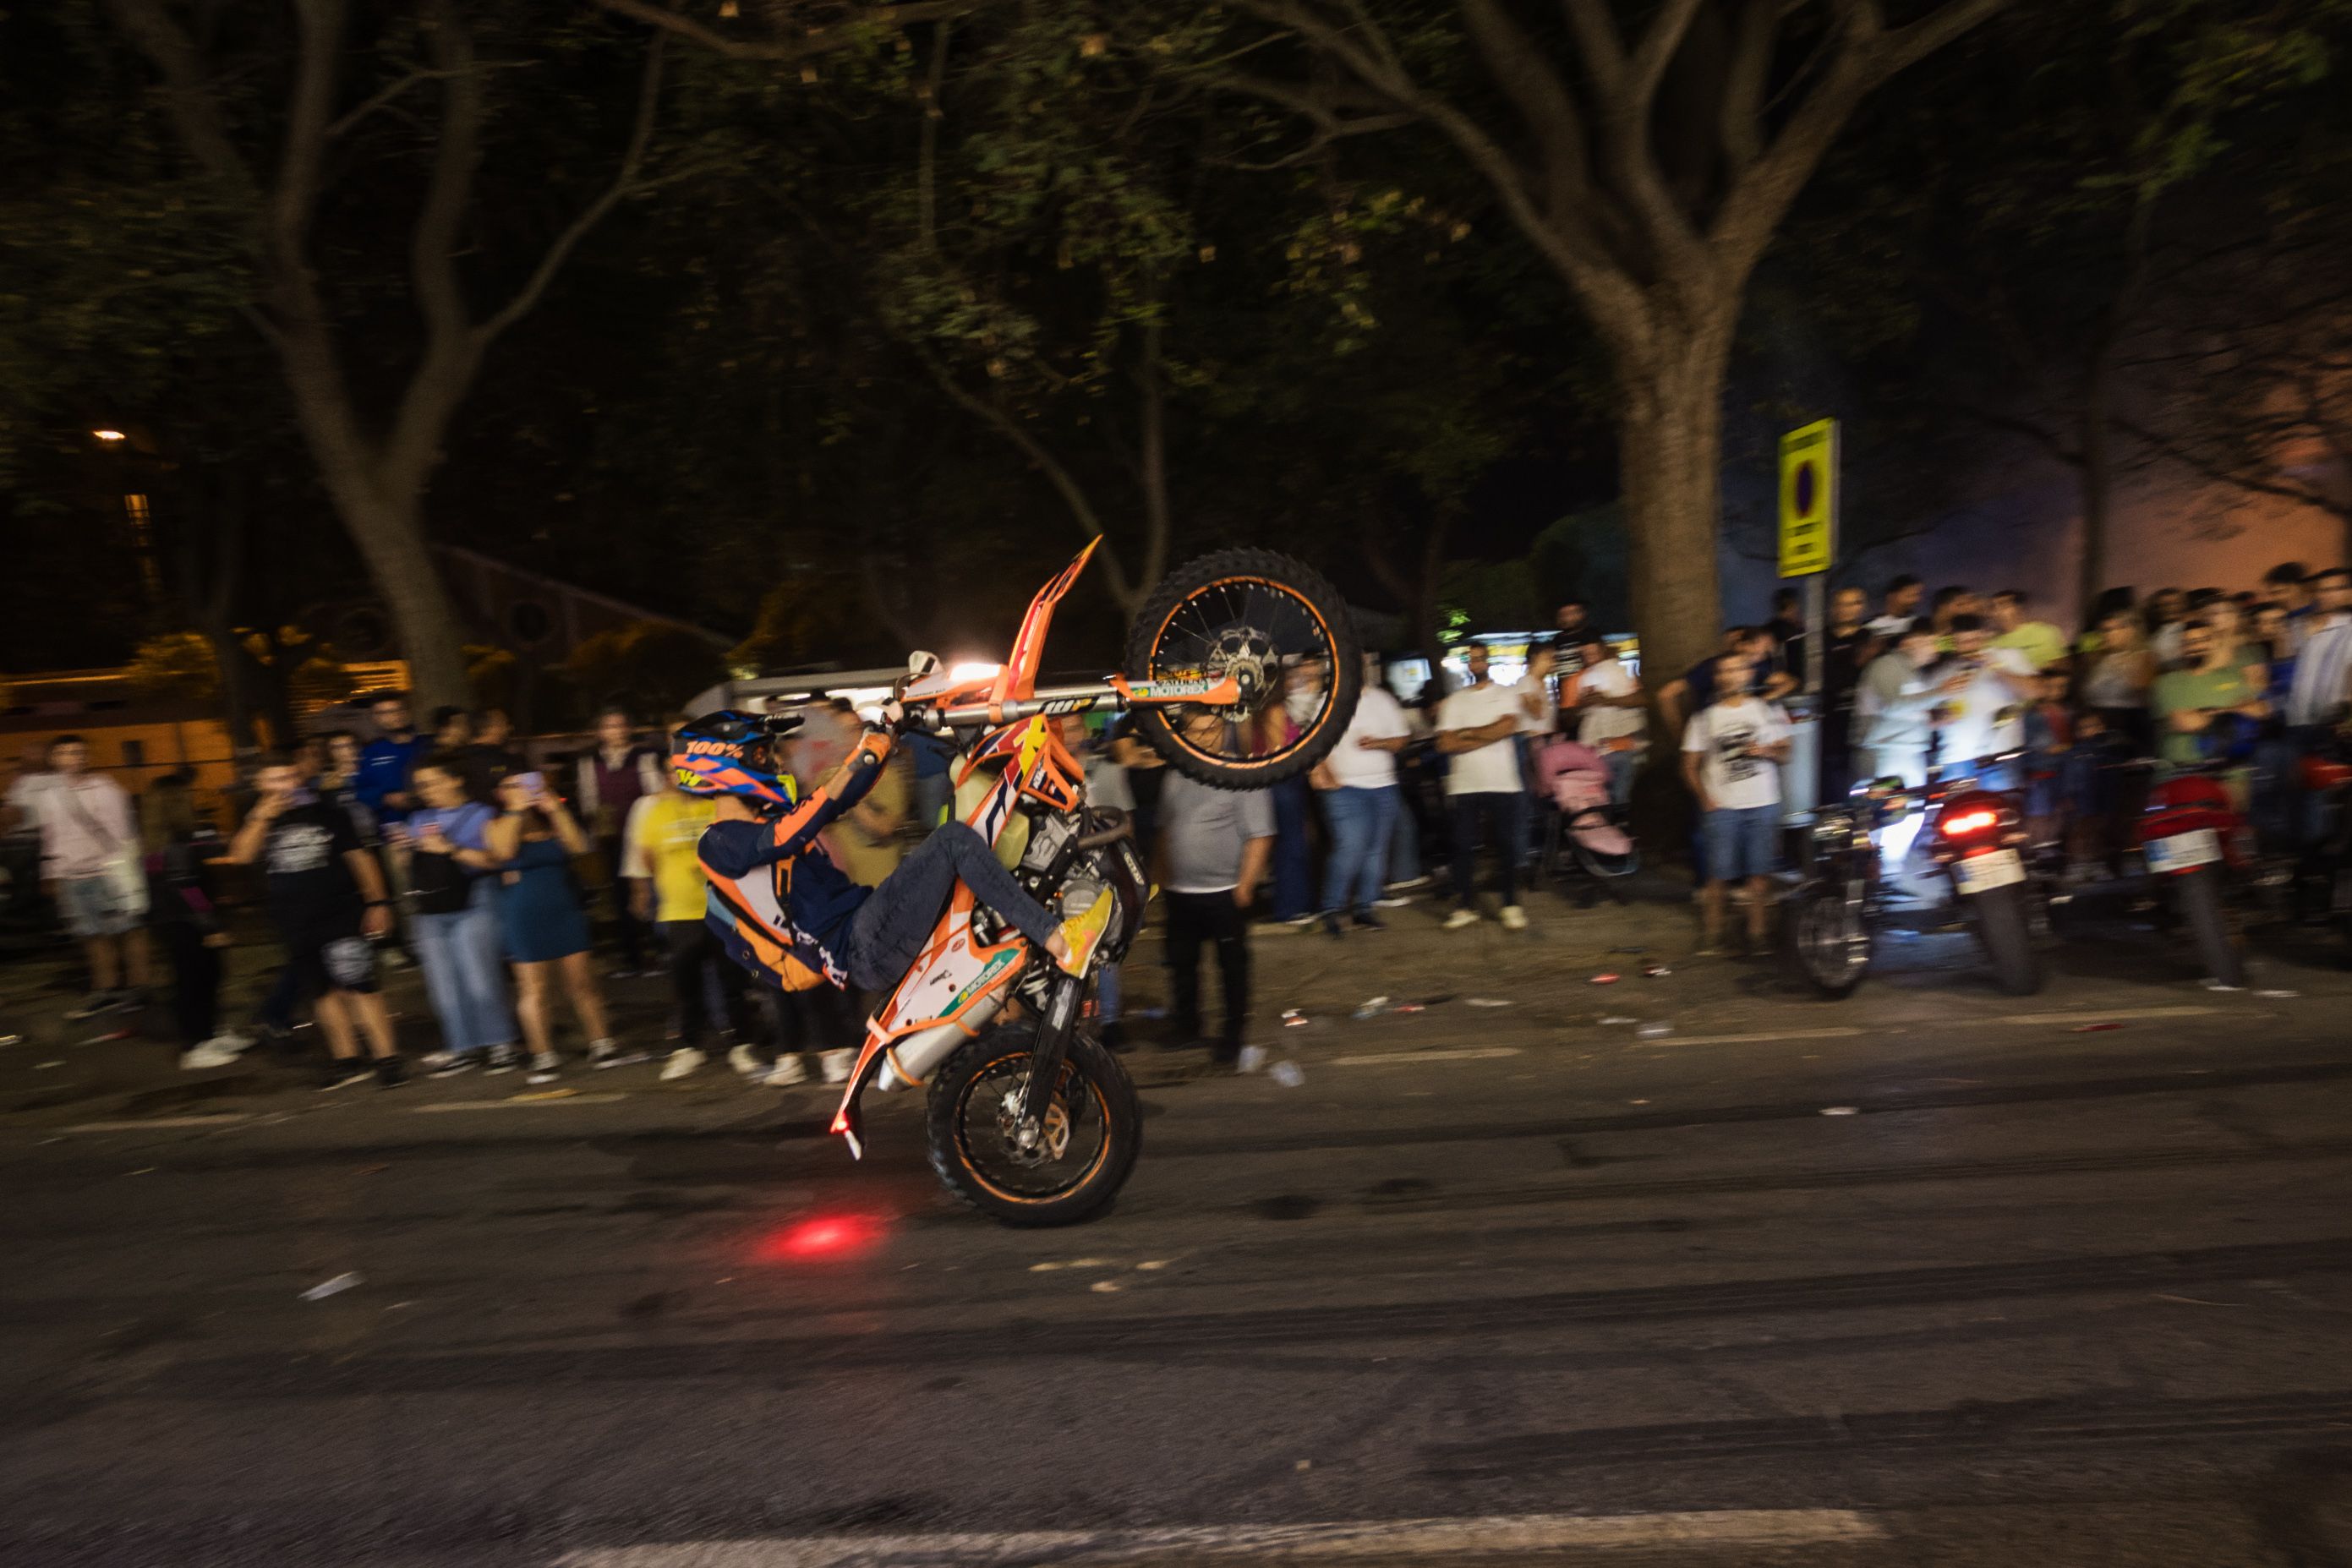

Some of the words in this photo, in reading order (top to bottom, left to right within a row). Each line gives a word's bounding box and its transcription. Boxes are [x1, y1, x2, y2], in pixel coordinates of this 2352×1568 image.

[1151, 683, 1204, 697] MOTOREX
[1045, 698, 1092, 714] WP
[686, 740, 744, 758] 100%
[966, 959, 1005, 994] MOTOREX
